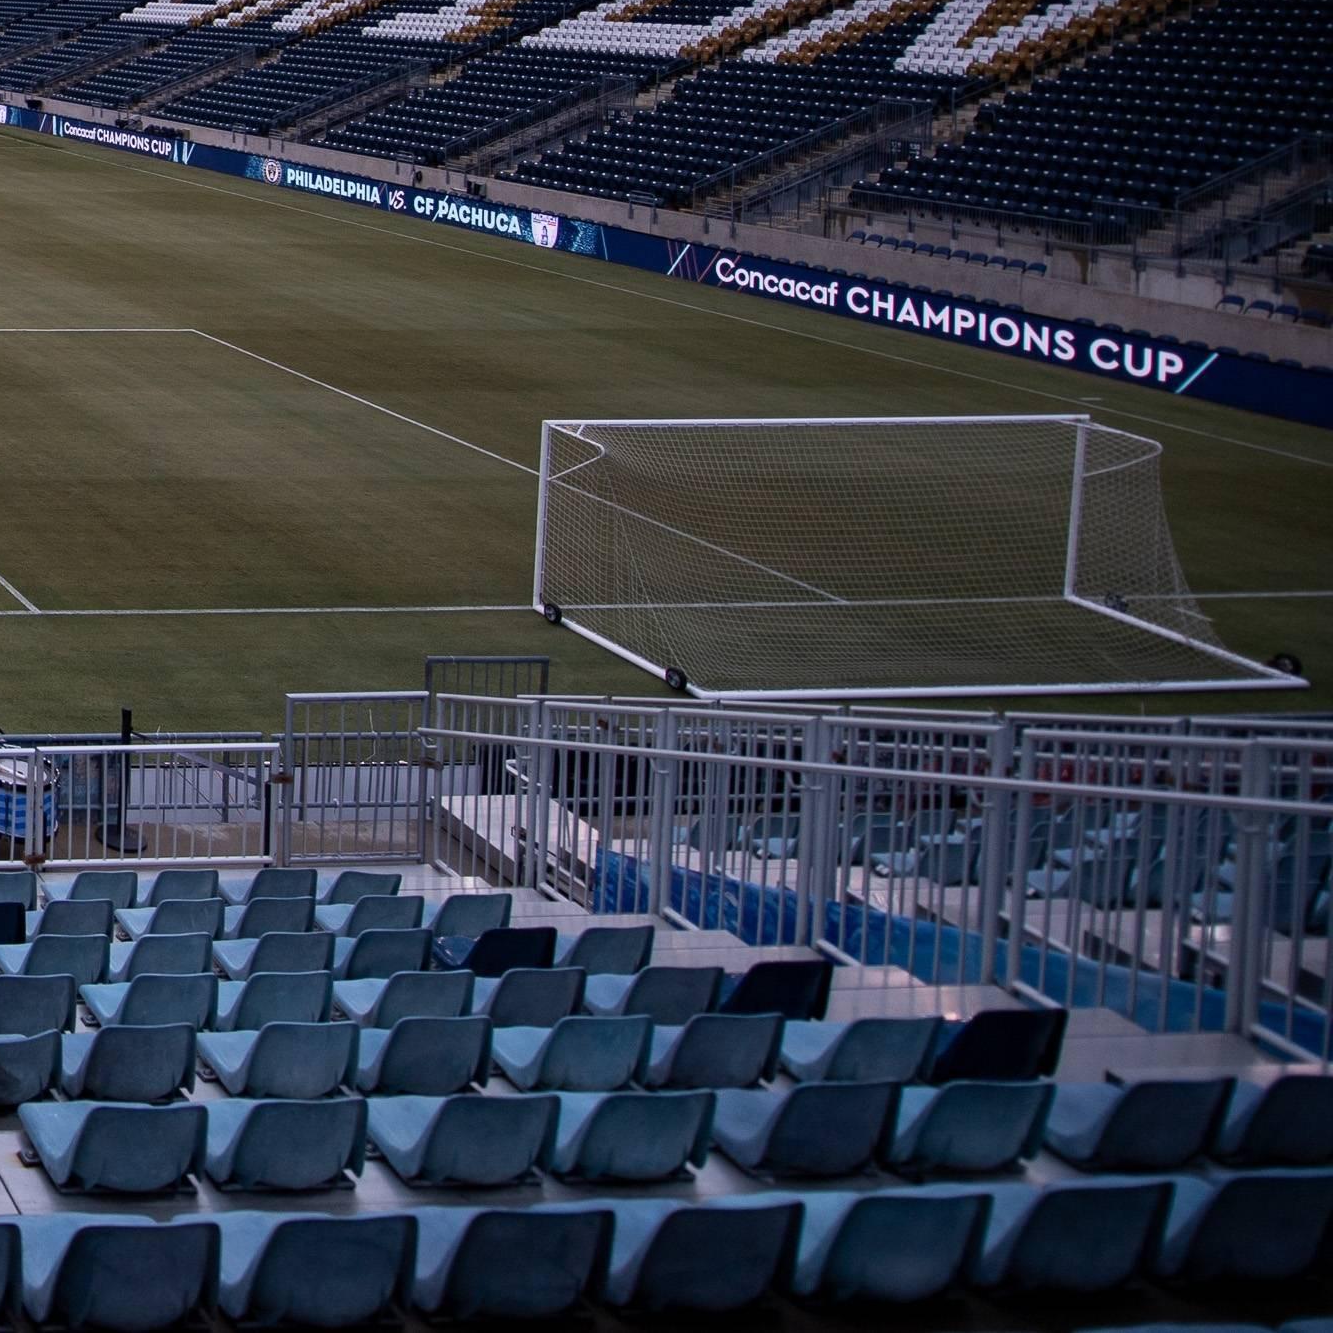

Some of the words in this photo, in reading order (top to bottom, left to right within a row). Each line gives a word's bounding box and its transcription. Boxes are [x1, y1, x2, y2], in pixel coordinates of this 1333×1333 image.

[64, 121, 96, 142] Concacaf
[96, 128, 150, 153] CHAMPIONS
[150, 138, 172, 158] CUP
[286, 168, 381, 205] PHILADELPHIA
[413, 195, 434, 217] CF
[436, 200, 522, 237] PACHUCA
[715, 257, 838, 307] Concacaf
[846, 286, 1076, 362] CHAMPIONS
[1088, 337, 1184, 385] CUP
